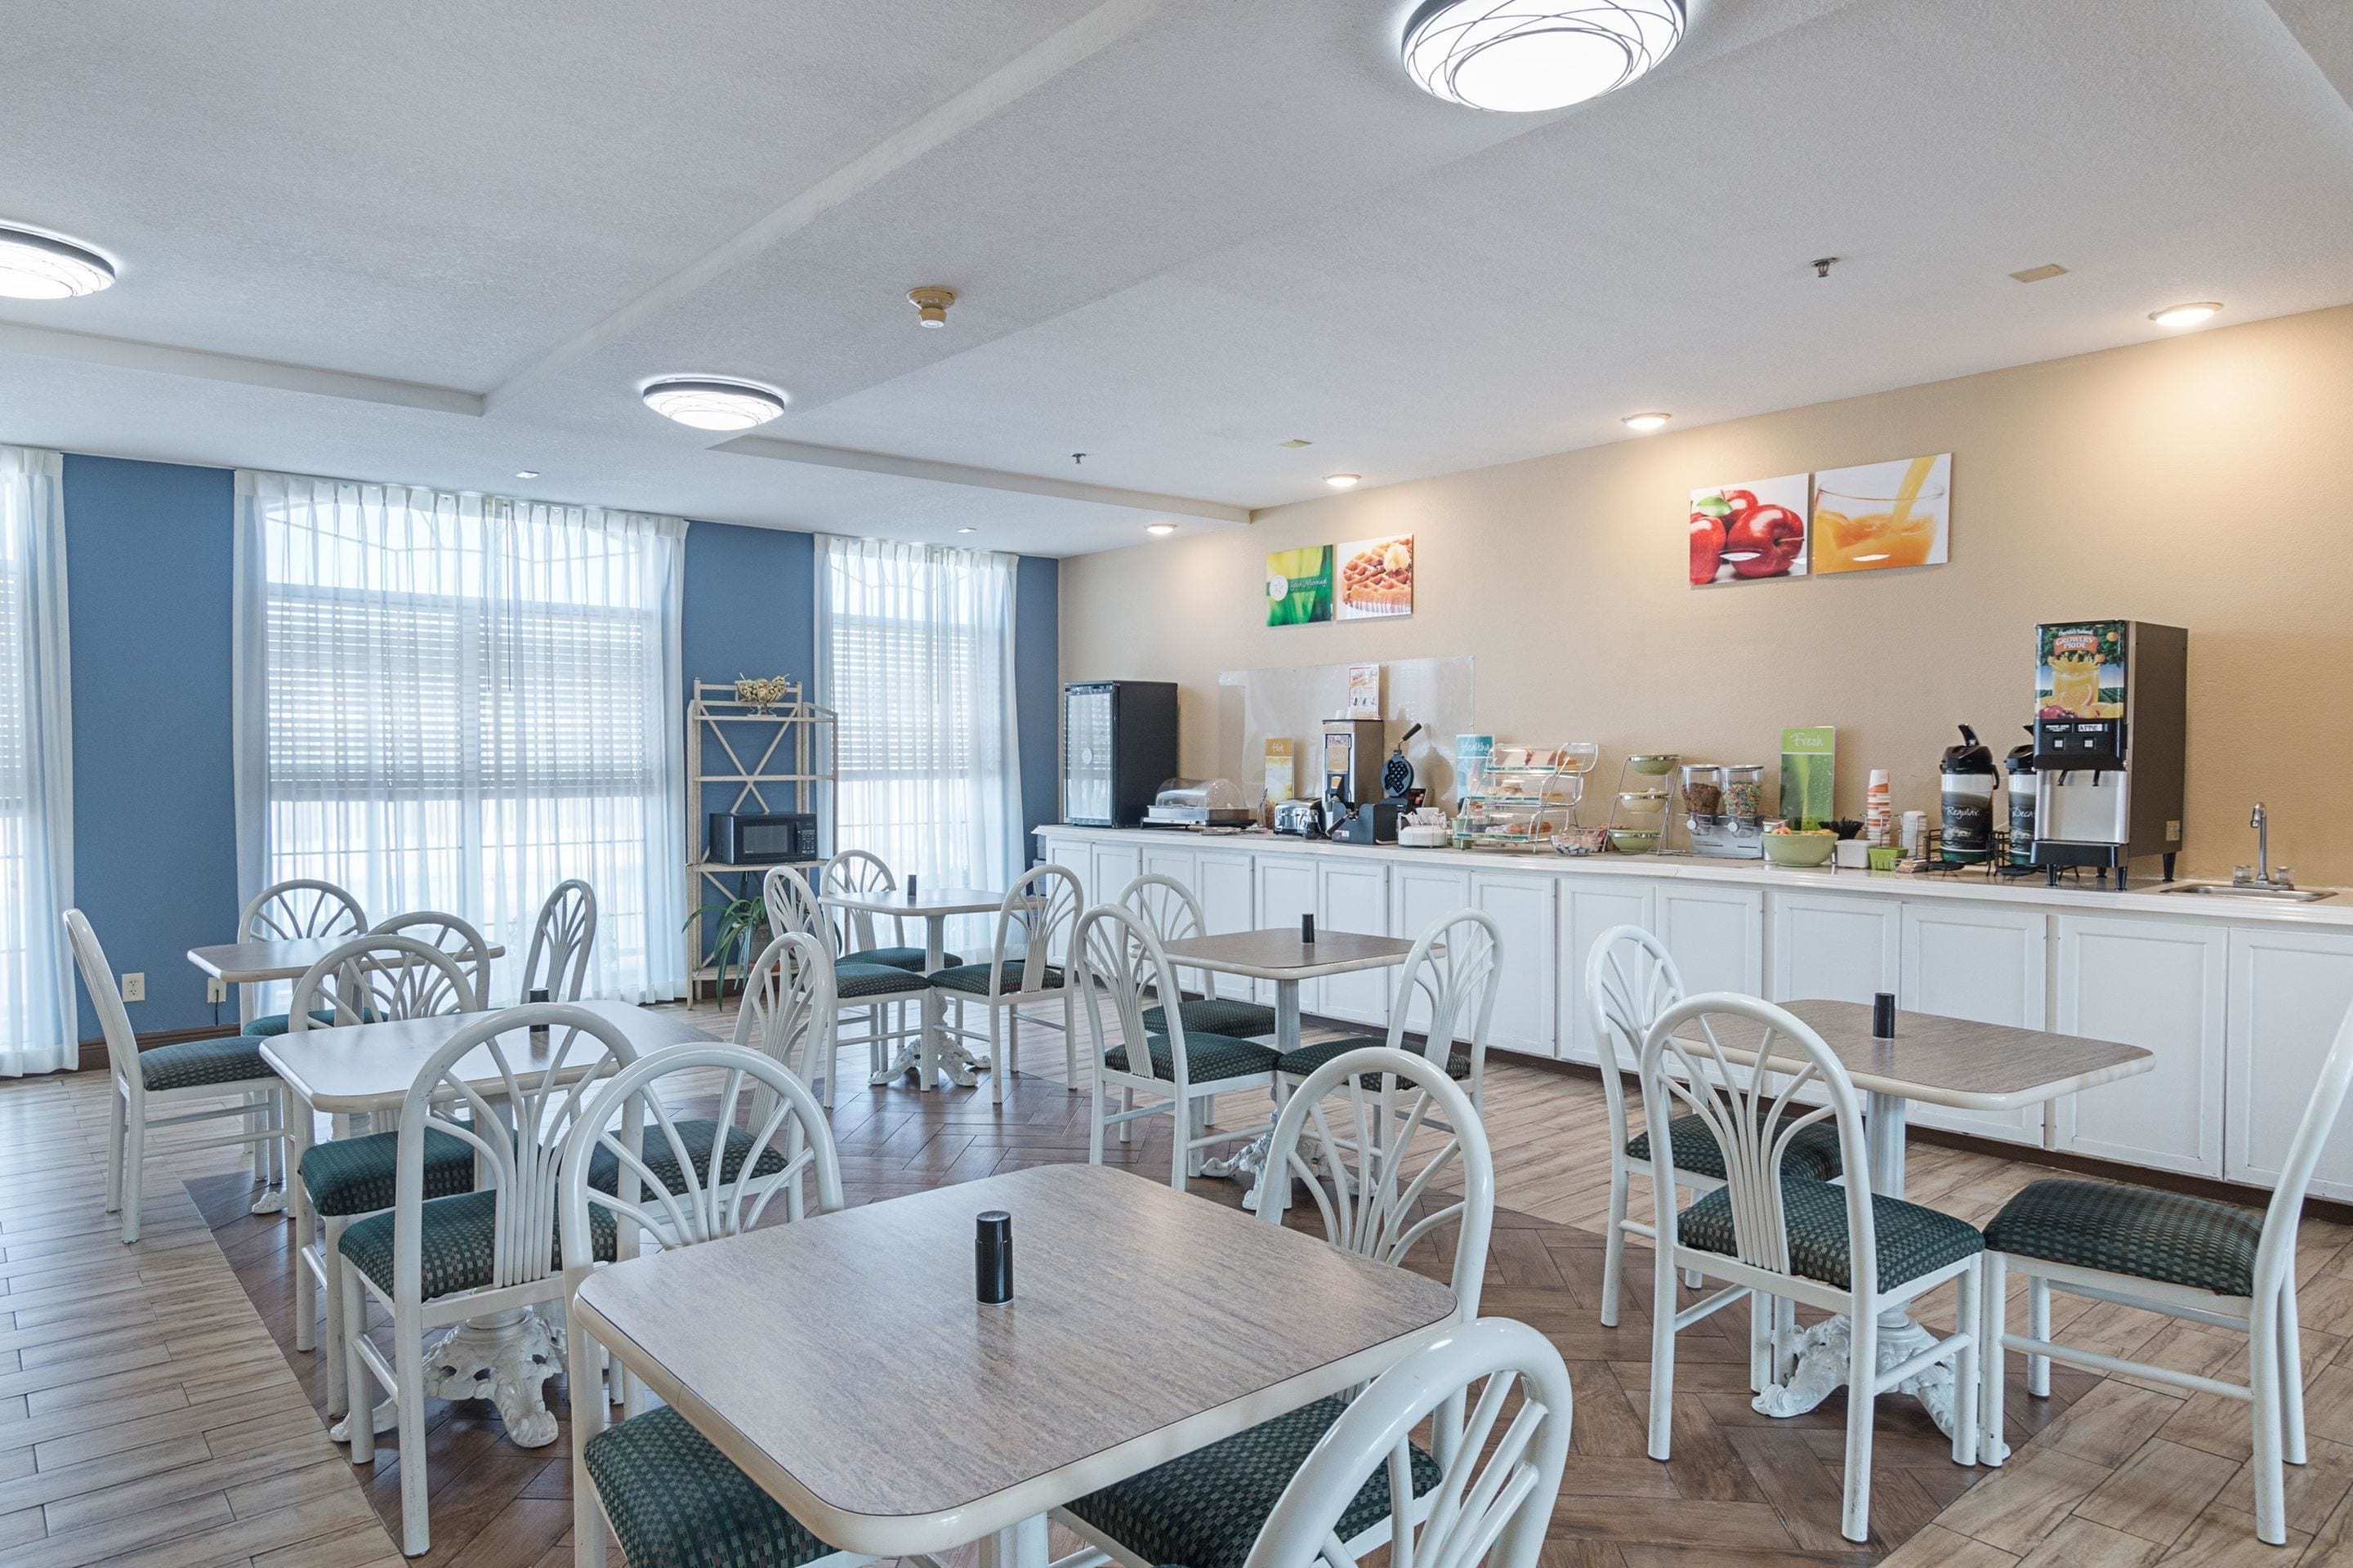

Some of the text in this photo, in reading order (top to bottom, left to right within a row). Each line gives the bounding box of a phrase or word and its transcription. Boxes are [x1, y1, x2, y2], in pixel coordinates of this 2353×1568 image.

[1789, 732, 1824, 747] Fresh
[1460, 742, 1490, 755] Healthy
[1945, 806, 1980, 820] Regular
[2011, 806, 2035, 817] Deca
